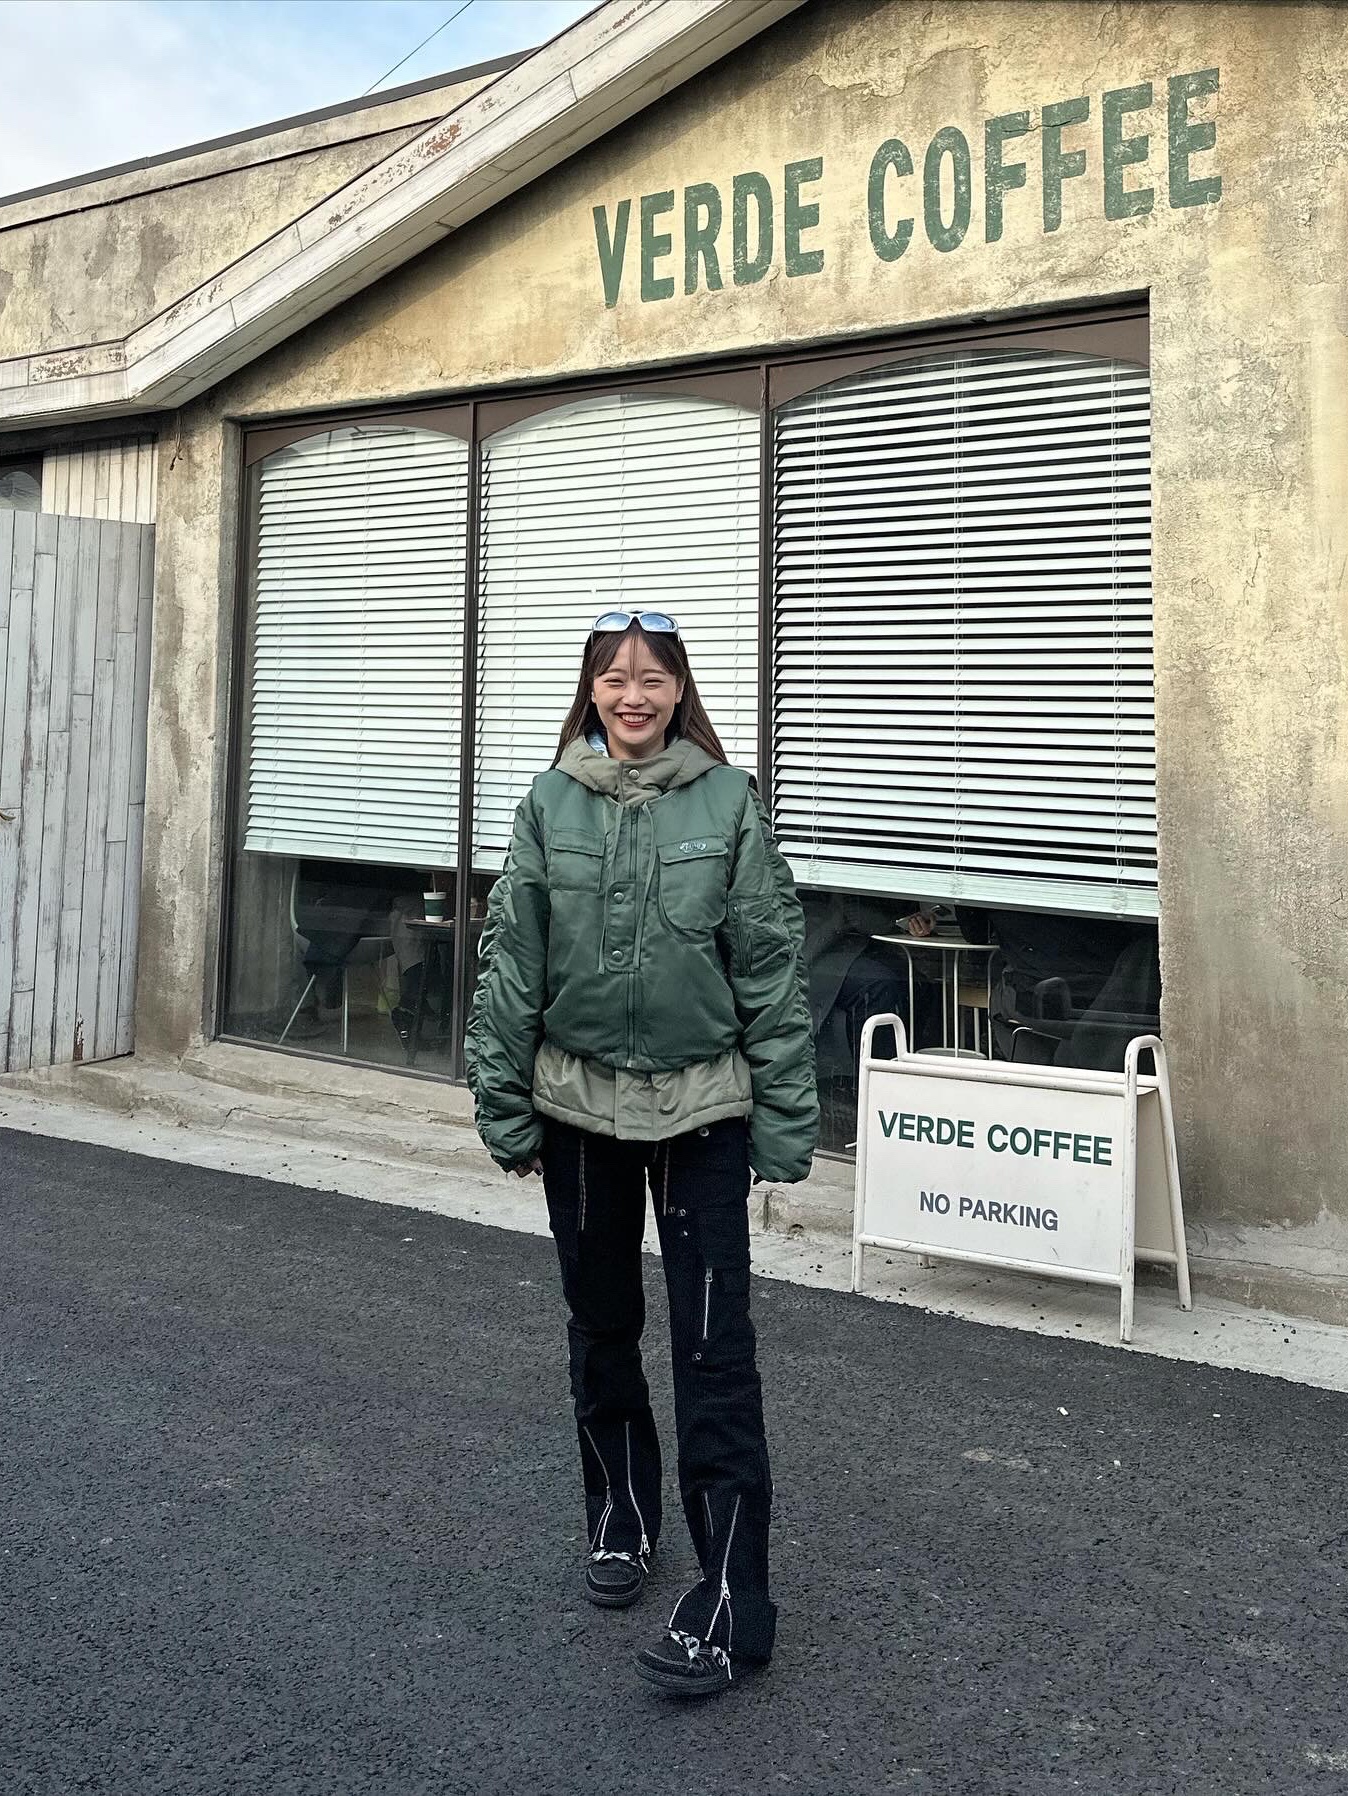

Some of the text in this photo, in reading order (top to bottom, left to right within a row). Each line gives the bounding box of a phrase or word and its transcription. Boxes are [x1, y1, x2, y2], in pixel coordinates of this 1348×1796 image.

[592, 66, 1222, 310] VERDE COFFEE
[877, 1110, 1113, 1166] VERDE COFFEE
[919, 1191, 1059, 1232] NO PARKING
